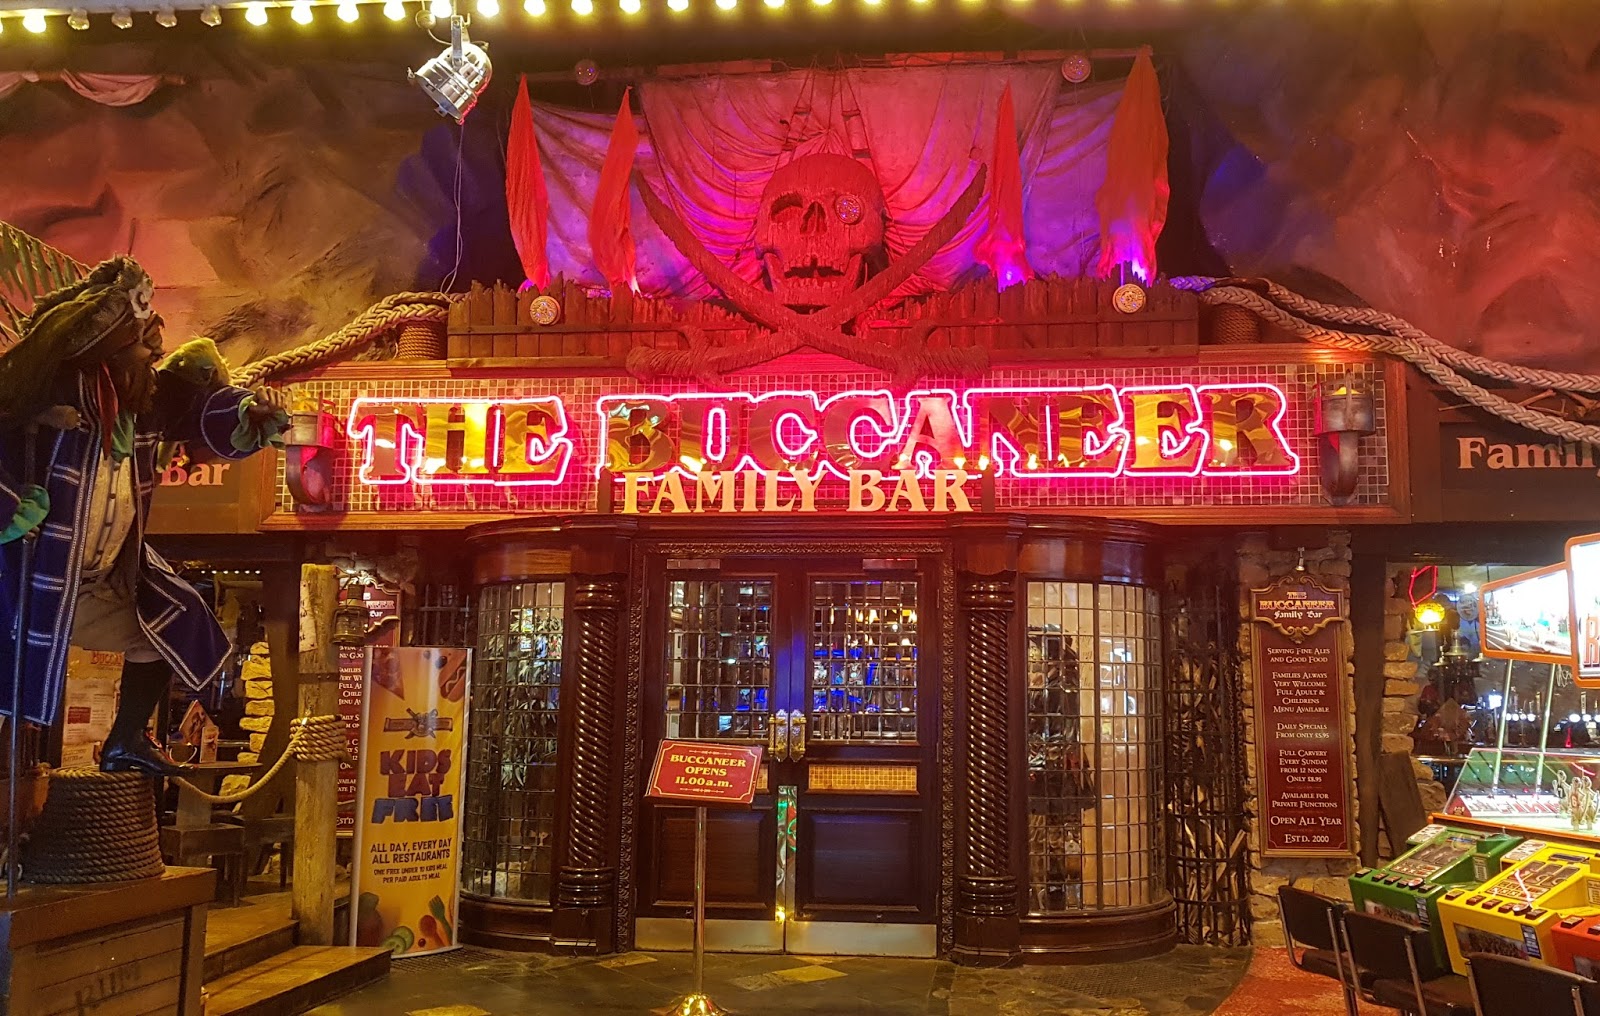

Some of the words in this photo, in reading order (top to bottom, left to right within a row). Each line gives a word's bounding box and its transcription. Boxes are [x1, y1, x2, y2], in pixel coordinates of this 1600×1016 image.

[347, 396, 574, 486] THE
[596, 383, 1300, 482] BUCCANEER
[1457, 437, 1600, 478] Famil
[159, 456, 230, 486] Bar
[621, 469, 827, 514] FAMILY
[846, 468, 973, 513] BAR
[1287, 591, 1307, 599] THE
[1259, 600, 1336, 610] BUCCANEER
[1274, 610, 1303, 620] Family
[1306, 610, 1322, 618] Bar
[1267, 647, 1295, 655] SERVING
[1297, 647, 1313, 655] FINE
[1314, 647, 1331, 655] ALES
[1285, 656, 1308, 664] GOOD
[1308, 656, 1329, 664] FOOD
[1272, 671, 1301, 679] FAMILIES
[1302, 671, 1328, 679] ALWAYS
[1273, 680, 1291, 688] VERY
[1276, 688, 1293, 696] FULL
[1282, 697, 1320, 705] CHILDRENS
[1273, 706, 1295, 714] MENU
[1296, 706, 1330, 714] AVAILABLE
[1277, 722, 1298, 730] DAILY
[1298, 722, 1328, 731] SPECIALS
[1275, 731, 1295, 739] FROM
[1279, 749, 1297, 757] FULL
[1297, 749, 1328, 758] CARVERY
[380, 749, 451, 775] KIDS
[669, 754, 747, 768] BUCCANEER
[1279, 757, 1300, 766] EVERY
[1301, 757, 1328, 766] SUNDAY
[685, 766, 727, 776] OPENS
[1286, 774, 1307, 783] ONLY
[387, 771, 446, 798] EAT
[1281, 791, 1315, 800] AVAILABLE
[1272, 800, 1299, 808] PRIVATE
[1299, 800, 1338, 808] FUNCTIONS
[371, 795, 454, 824] FREE
[1270, 815, 1297, 826] OPEN
[1298, 816, 1318, 826] ALL
[1318, 816, 1342, 827] YEAR
[1312, 835, 1330, 843] 2000
[370, 843, 388, 854] ALL
[412, 839, 438, 851] EVERY
[438, 837, 452, 848] DAY
[372, 854, 391, 865] ALL
[392, 848, 450, 864] RESTAURANTS
